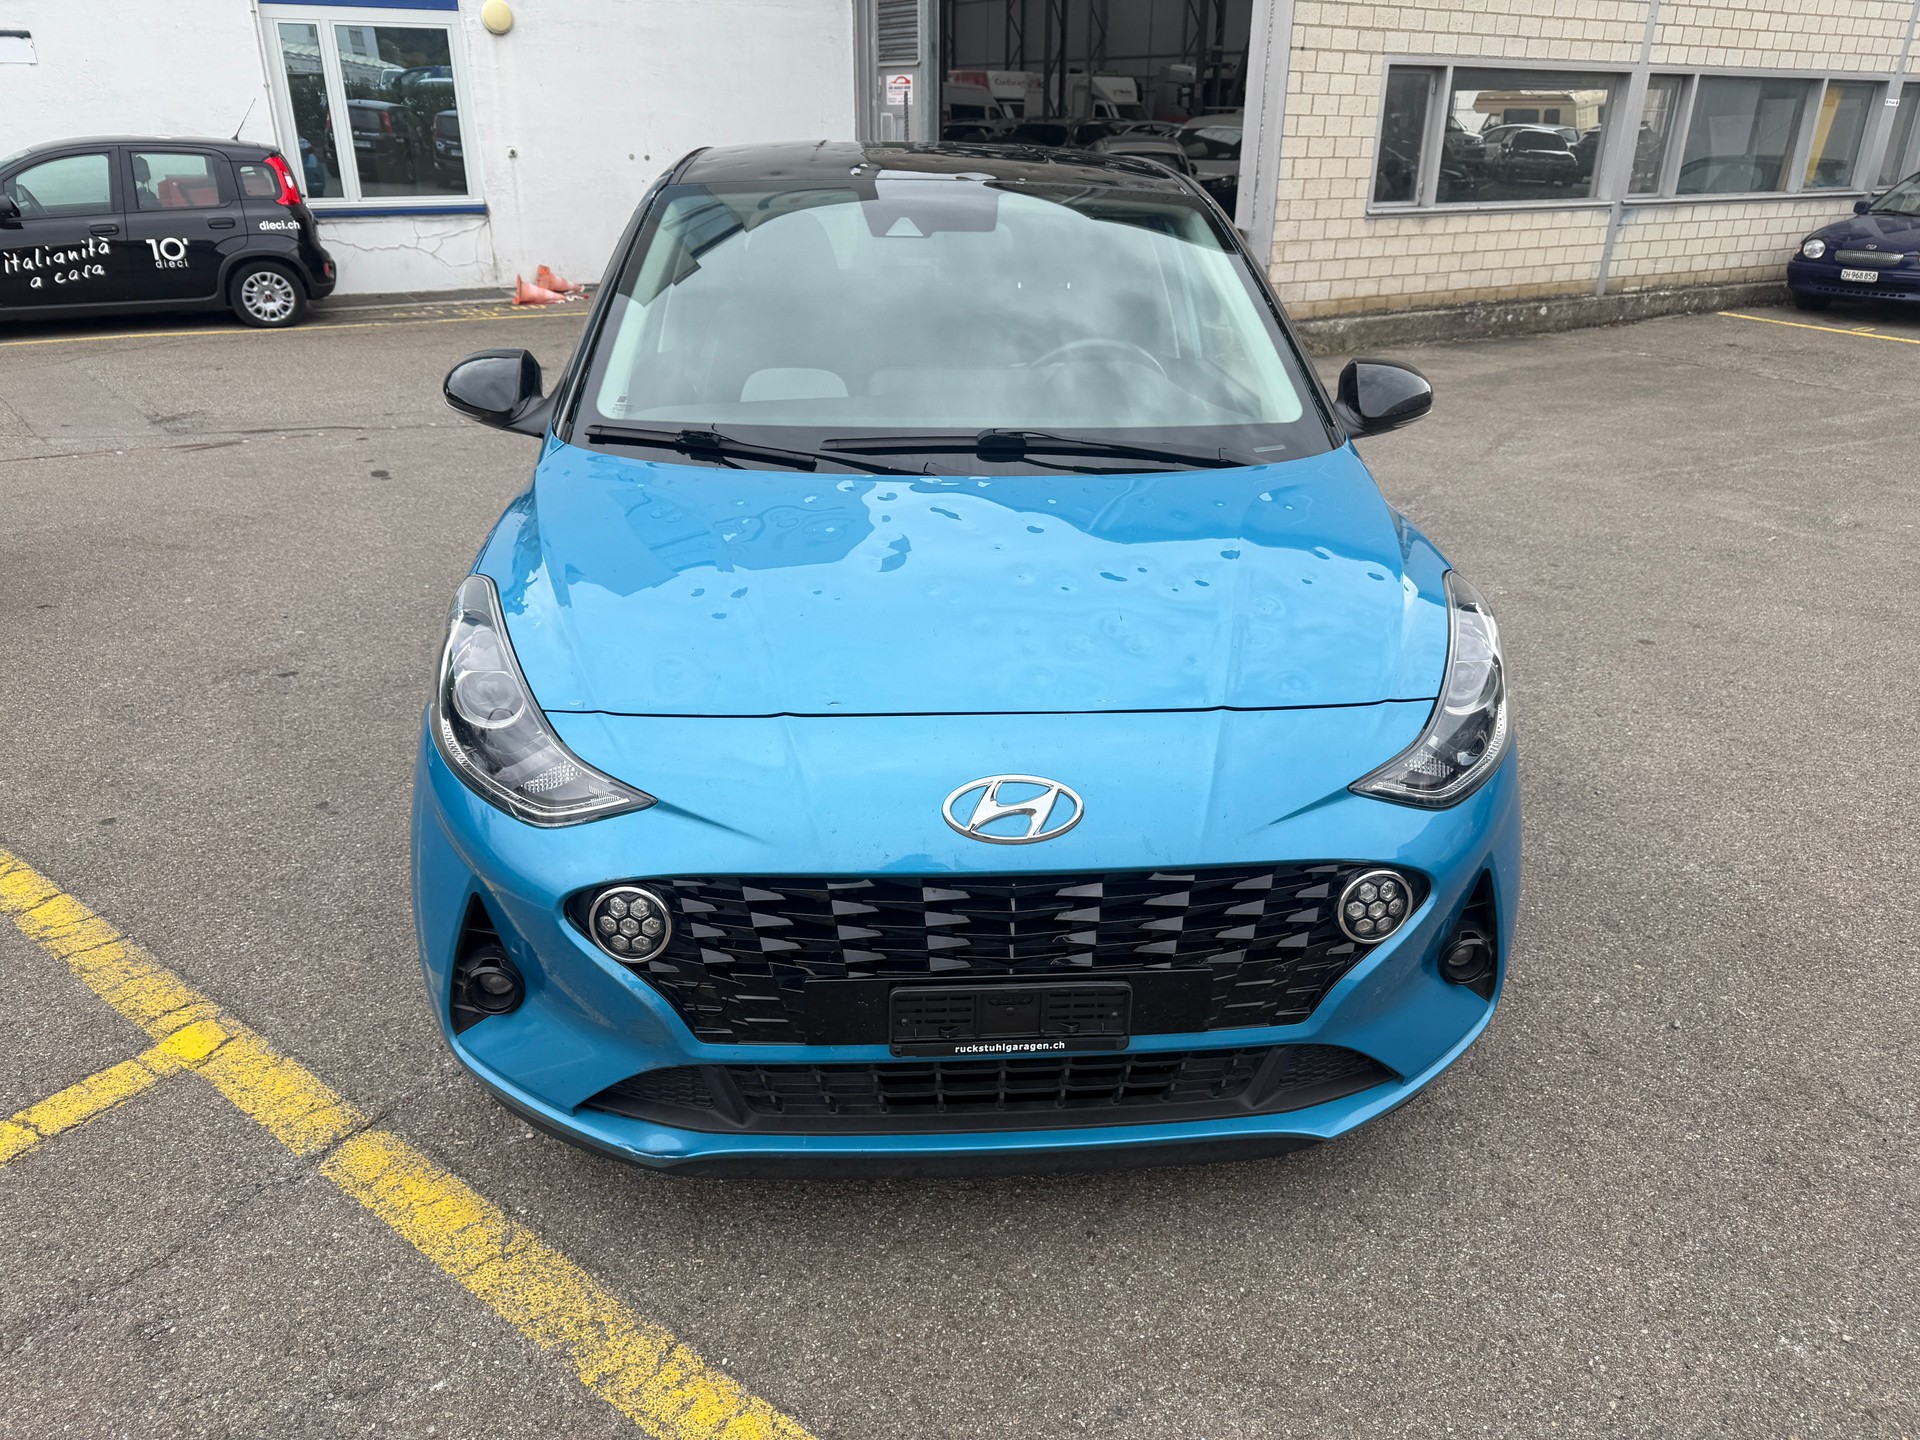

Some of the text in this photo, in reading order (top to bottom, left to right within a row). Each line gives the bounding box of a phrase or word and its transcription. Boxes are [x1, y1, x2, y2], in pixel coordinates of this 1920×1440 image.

[258, 219, 301, 231] dieci.ch
[3, 236, 111, 273] italianità
[155, 259, 189, 269] dieci
[30, 263, 105, 289] a casa
[954, 1041, 1066, 1054] ruckstuhlgaragen.ch
